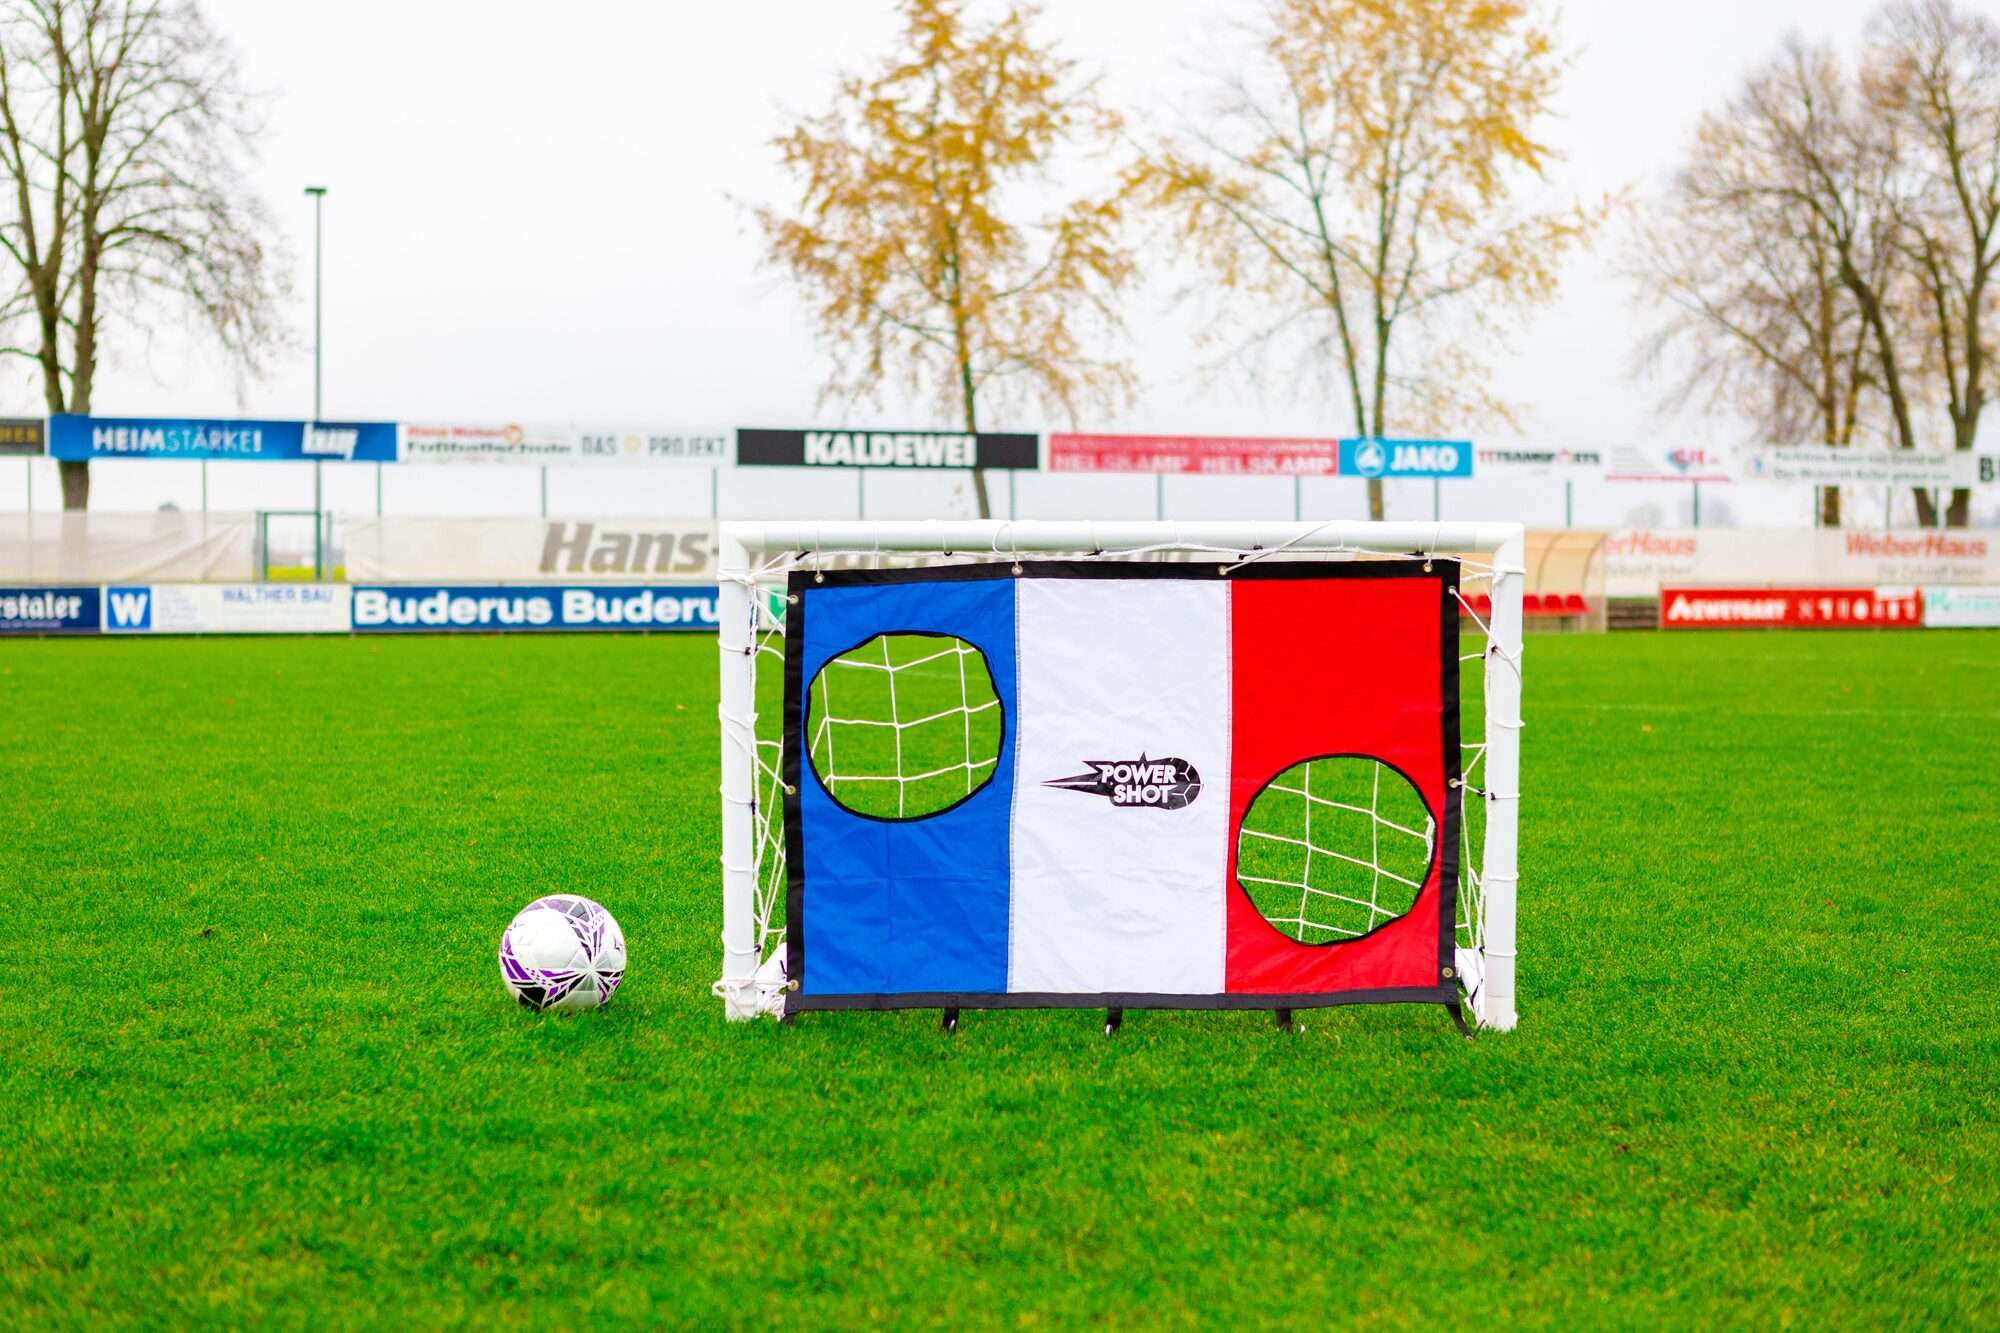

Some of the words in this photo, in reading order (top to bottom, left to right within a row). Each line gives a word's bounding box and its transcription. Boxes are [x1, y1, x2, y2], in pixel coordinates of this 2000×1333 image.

[649, 437, 725, 458] PROJEKT
[804, 432, 977, 466] KALDEWEI
[1390, 445, 1459, 471] JAKO
[1846, 530, 1988, 558] WeberHaus
[110, 593, 148, 626] W
[354, 590, 552, 625] Buderus
[562, 590, 720, 625] Buderu
[1096, 763, 1177, 785] POWER
[1113, 784, 1178, 804] SHOT
